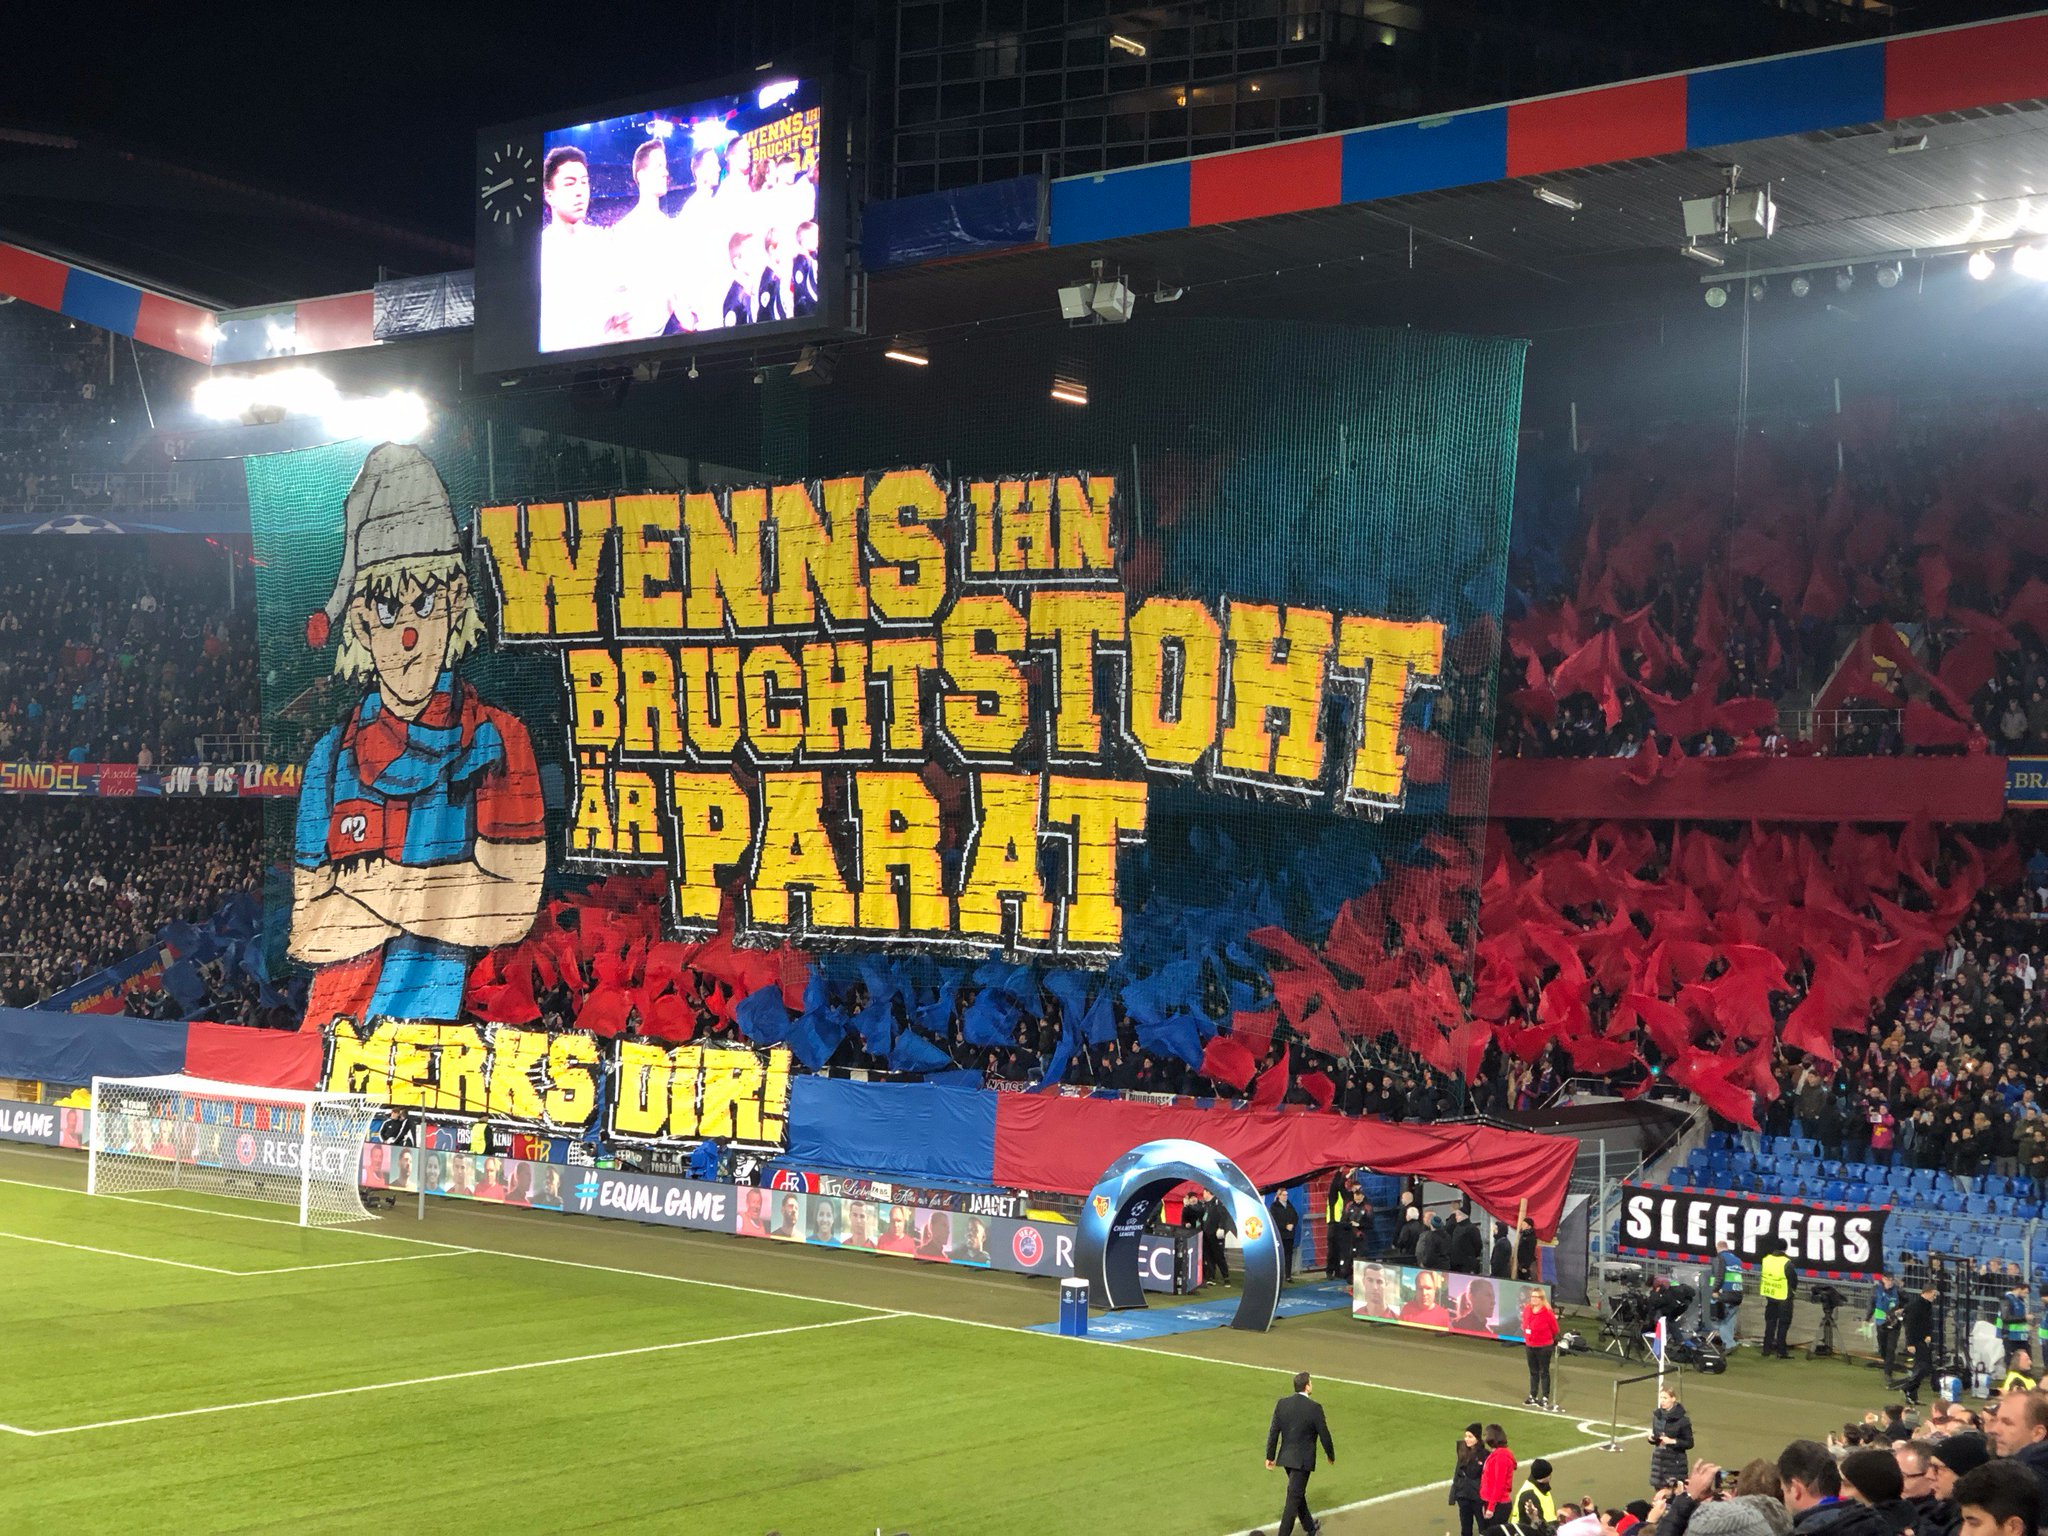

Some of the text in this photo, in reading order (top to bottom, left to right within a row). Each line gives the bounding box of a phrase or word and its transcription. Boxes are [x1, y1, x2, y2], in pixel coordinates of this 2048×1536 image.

[742, 111, 803, 147] WENNS
[476, 467, 1116, 637] WENNS IHN
[568, 590, 1445, 797] BRUCHT STOHT
[572, 750, 1148, 944] ÄR PARAT
[330, 1019, 599, 1124] MERKS
[1626, 1195, 1873, 1264] SLEEPERS
